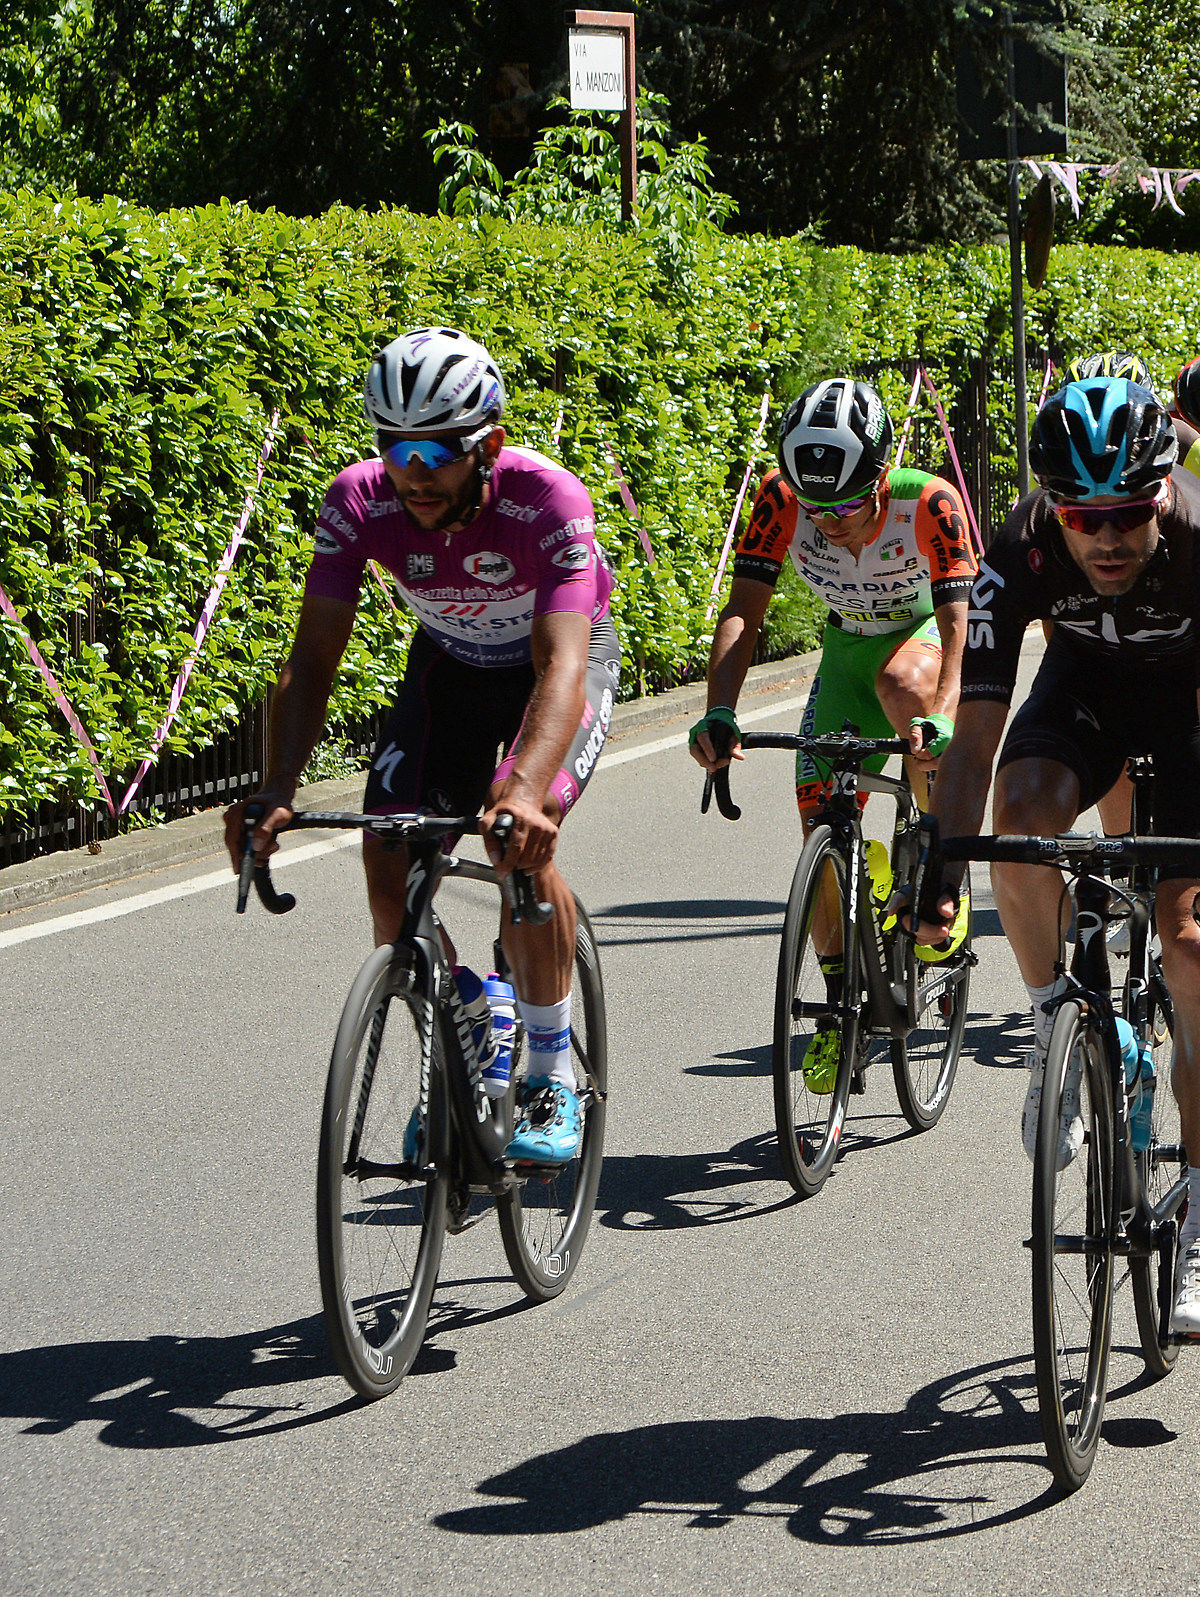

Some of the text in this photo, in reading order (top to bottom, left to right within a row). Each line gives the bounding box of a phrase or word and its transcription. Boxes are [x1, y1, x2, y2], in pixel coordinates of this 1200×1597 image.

[574, 43, 587, 57] VIA
[801, 474, 836, 484] BRIKO
[742, 473, 786, 551] CST
[928, 490, 977, 571] CST
[800, 540, 840, 564] CIPOLLINI
[930, 534, 949, 573] TIRES
[801, 566, 930, 593] BARDIANI
[968, 559, 1005, 650] SKY
[962, 684, 1009, 694] DEIGNAN
[798, 674, 822, 781] BARDNI
[1038, 840, 1057, 852] PR
[1096, 841, 1125, 853] PRO
